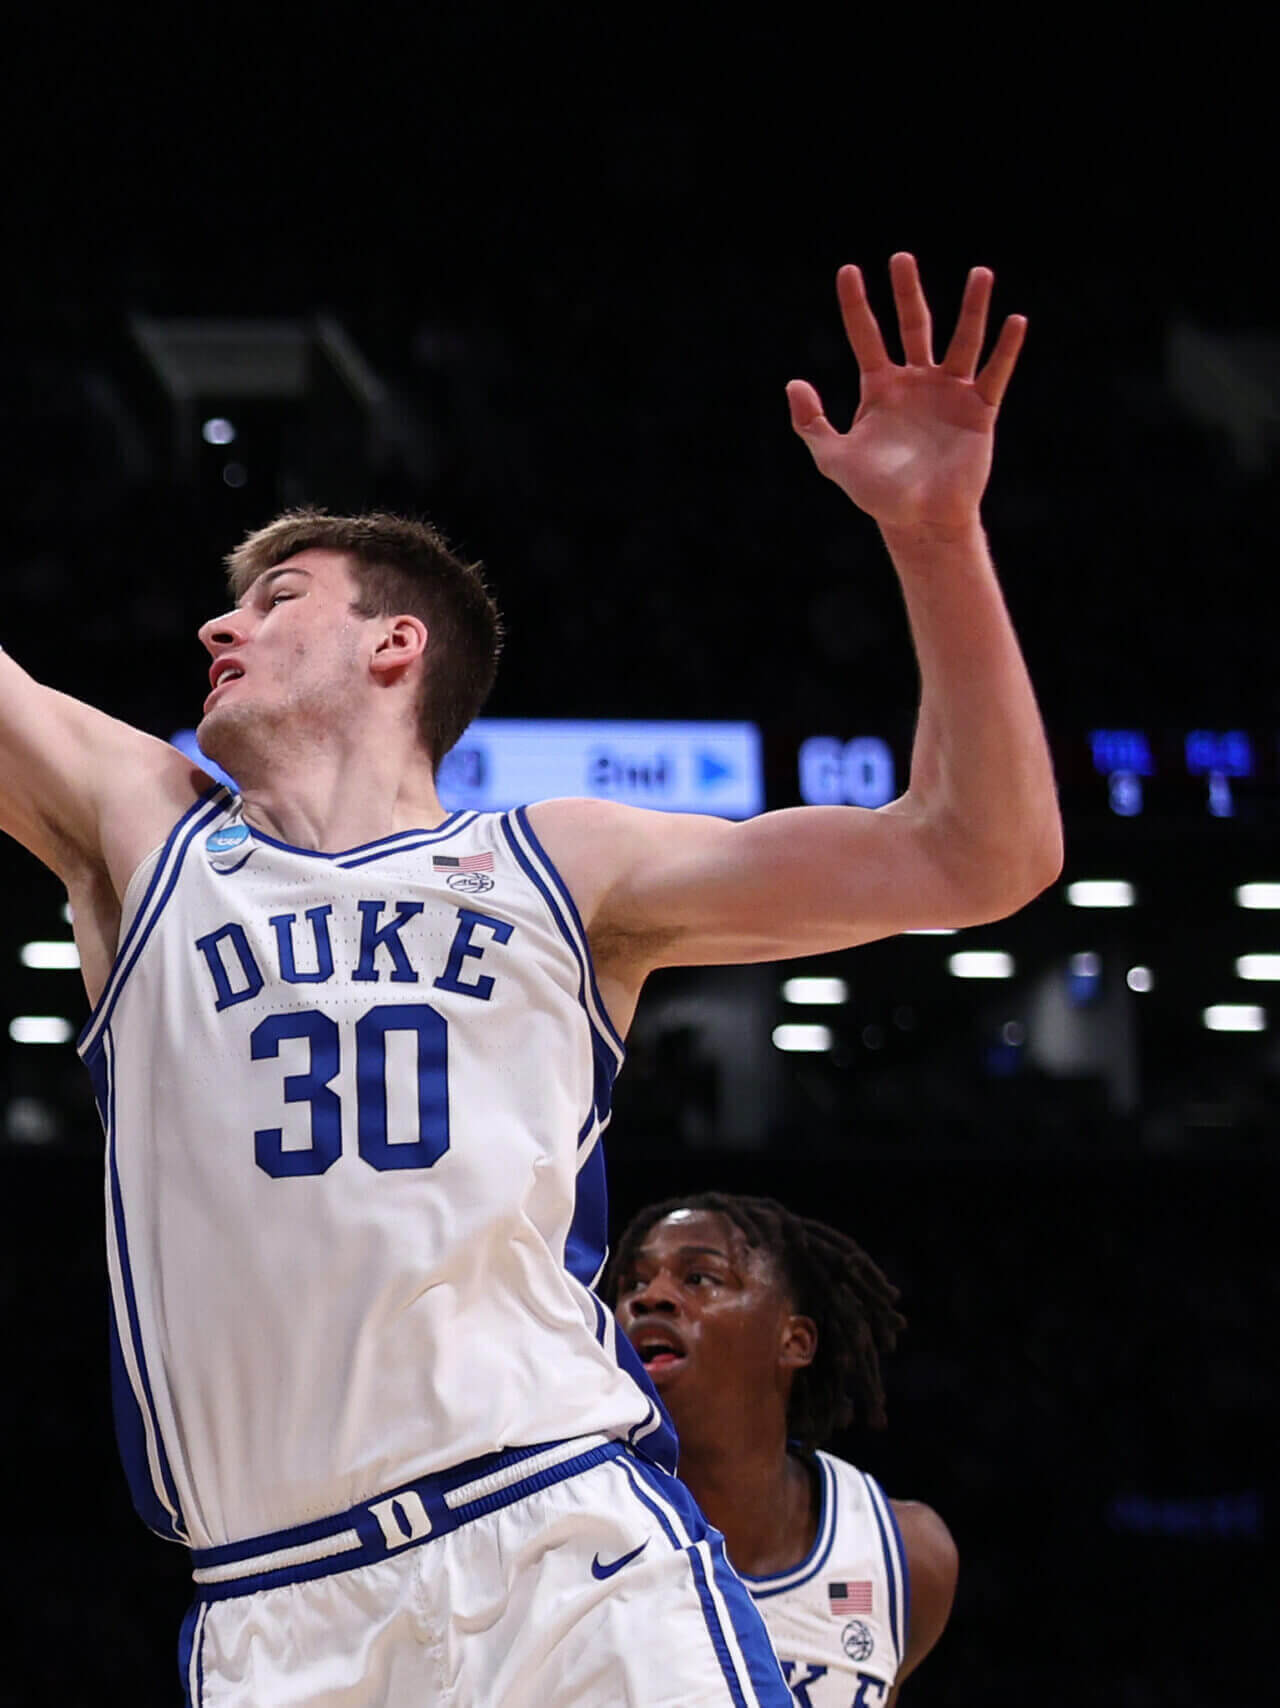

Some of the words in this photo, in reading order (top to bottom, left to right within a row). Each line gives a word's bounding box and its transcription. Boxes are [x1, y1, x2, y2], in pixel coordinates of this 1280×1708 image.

[195, 900, 515, 1012] DUKE
[250, 1003, 450, 1179] 30
[367, 1490, 433, 1550] D
